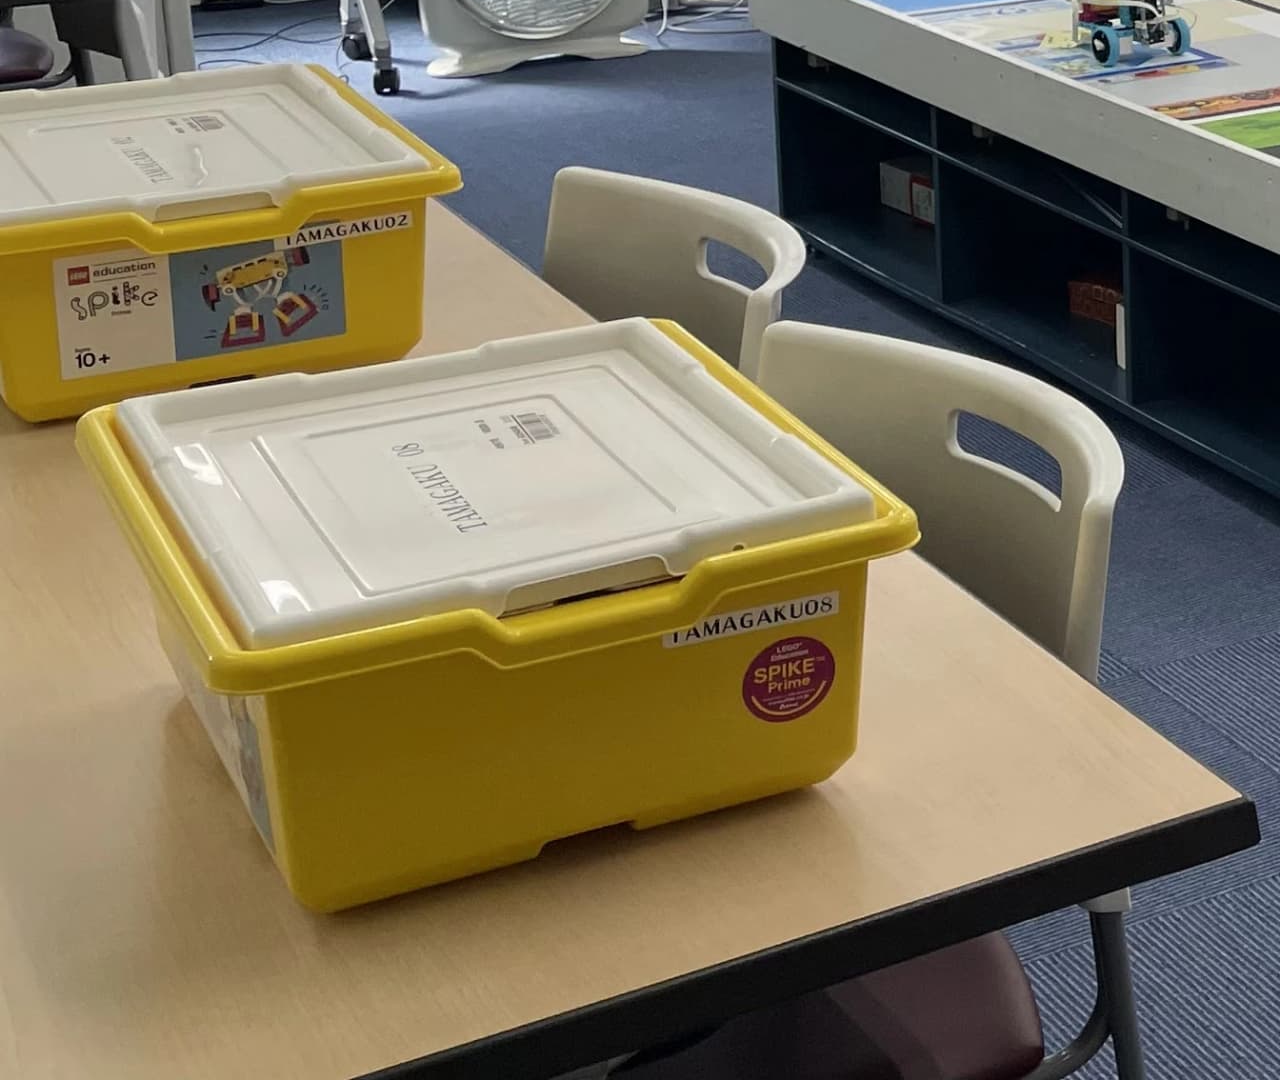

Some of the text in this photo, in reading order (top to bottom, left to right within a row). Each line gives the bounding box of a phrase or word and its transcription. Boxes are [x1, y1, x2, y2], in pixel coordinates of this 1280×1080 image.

[92, 261, 156, 278] education
[75, 352, 111, 369] 10+
[406, 464, 488, 533] TAMAGAKU
[754, 657, 816, 684] SPIKE
[768, 676, 811, 693] Prime
